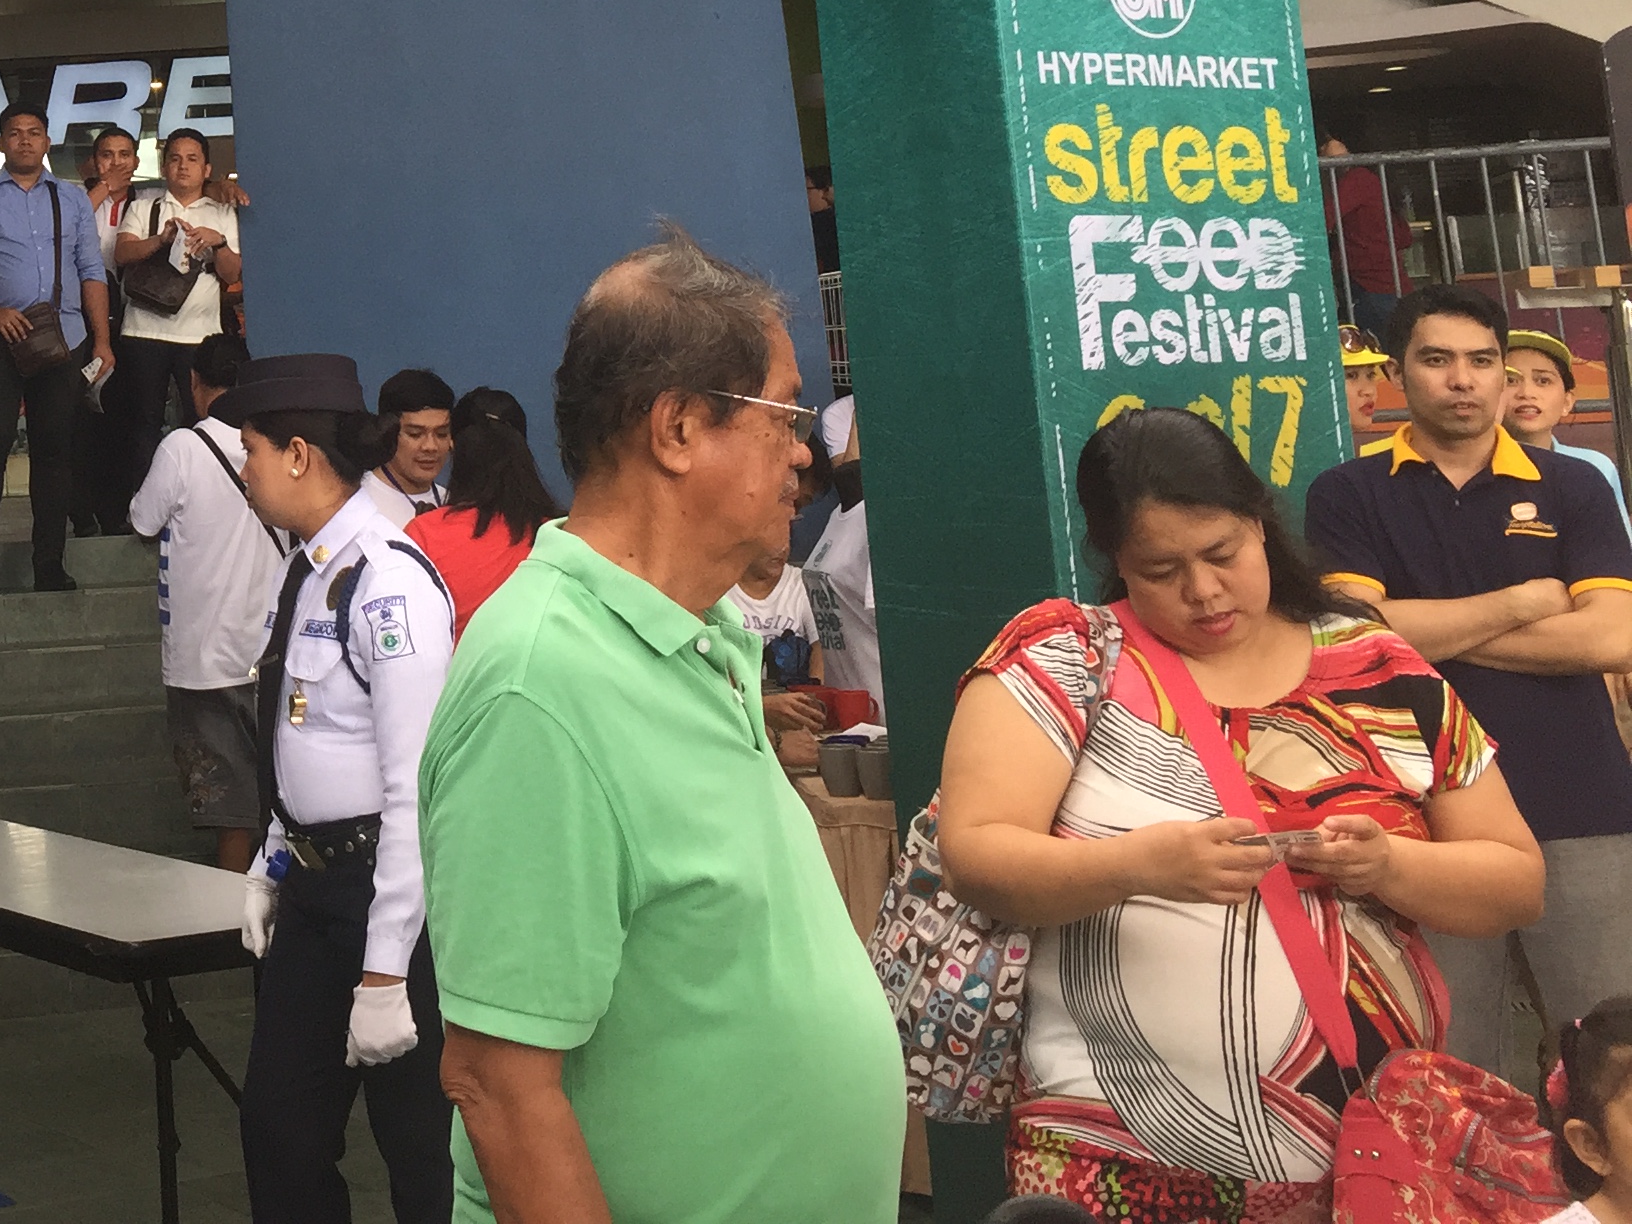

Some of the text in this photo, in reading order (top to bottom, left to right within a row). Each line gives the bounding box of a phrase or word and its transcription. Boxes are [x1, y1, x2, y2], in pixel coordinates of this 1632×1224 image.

[1037, 51, 1279, 90] HYPERMARKET
[1044, 104, 1299, 205] street
[1096, 373, 1308, 489] 17
